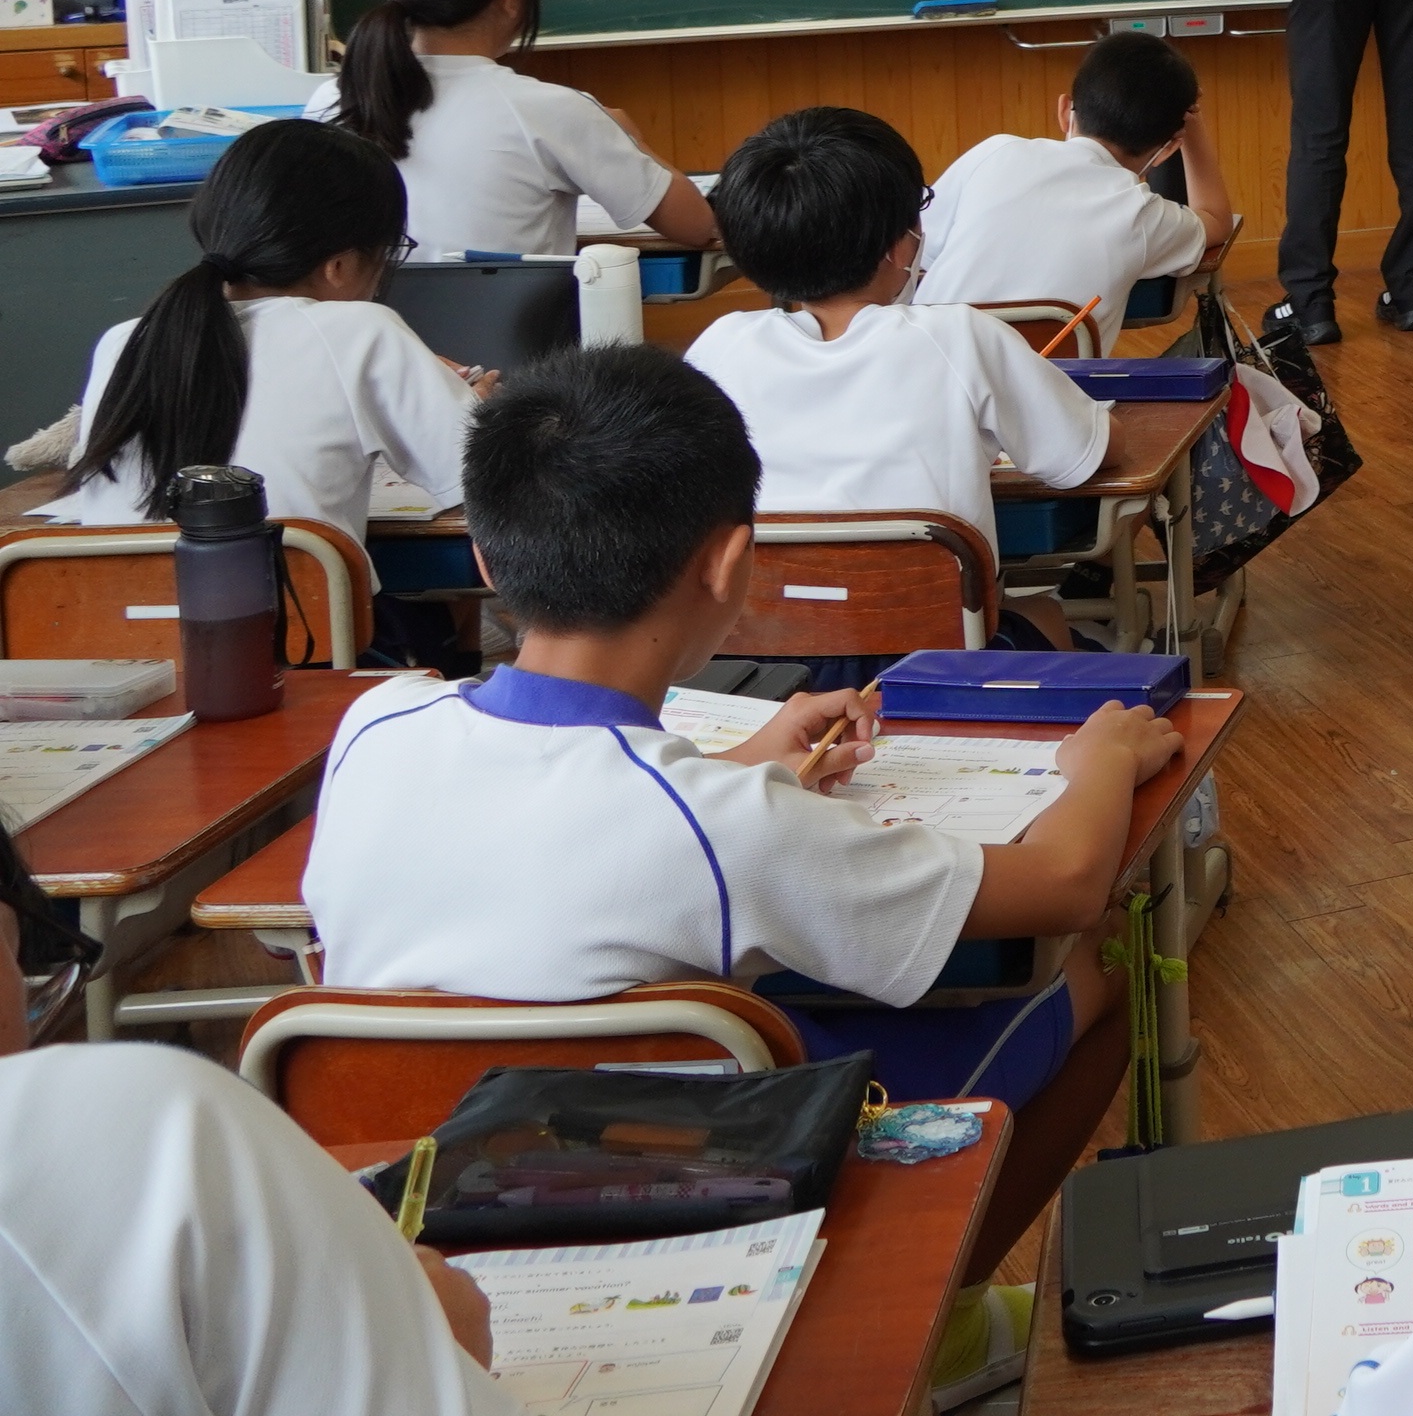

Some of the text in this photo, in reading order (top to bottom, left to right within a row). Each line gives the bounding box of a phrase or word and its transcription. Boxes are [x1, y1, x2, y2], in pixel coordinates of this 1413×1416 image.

[1360, 1176, 1373, 1194] 1
[1364, 1201, 1391, 1210] Words
[1392, 1201, 1408, 1209] and
[1361, 1324, 1411, 1334] Listen and
